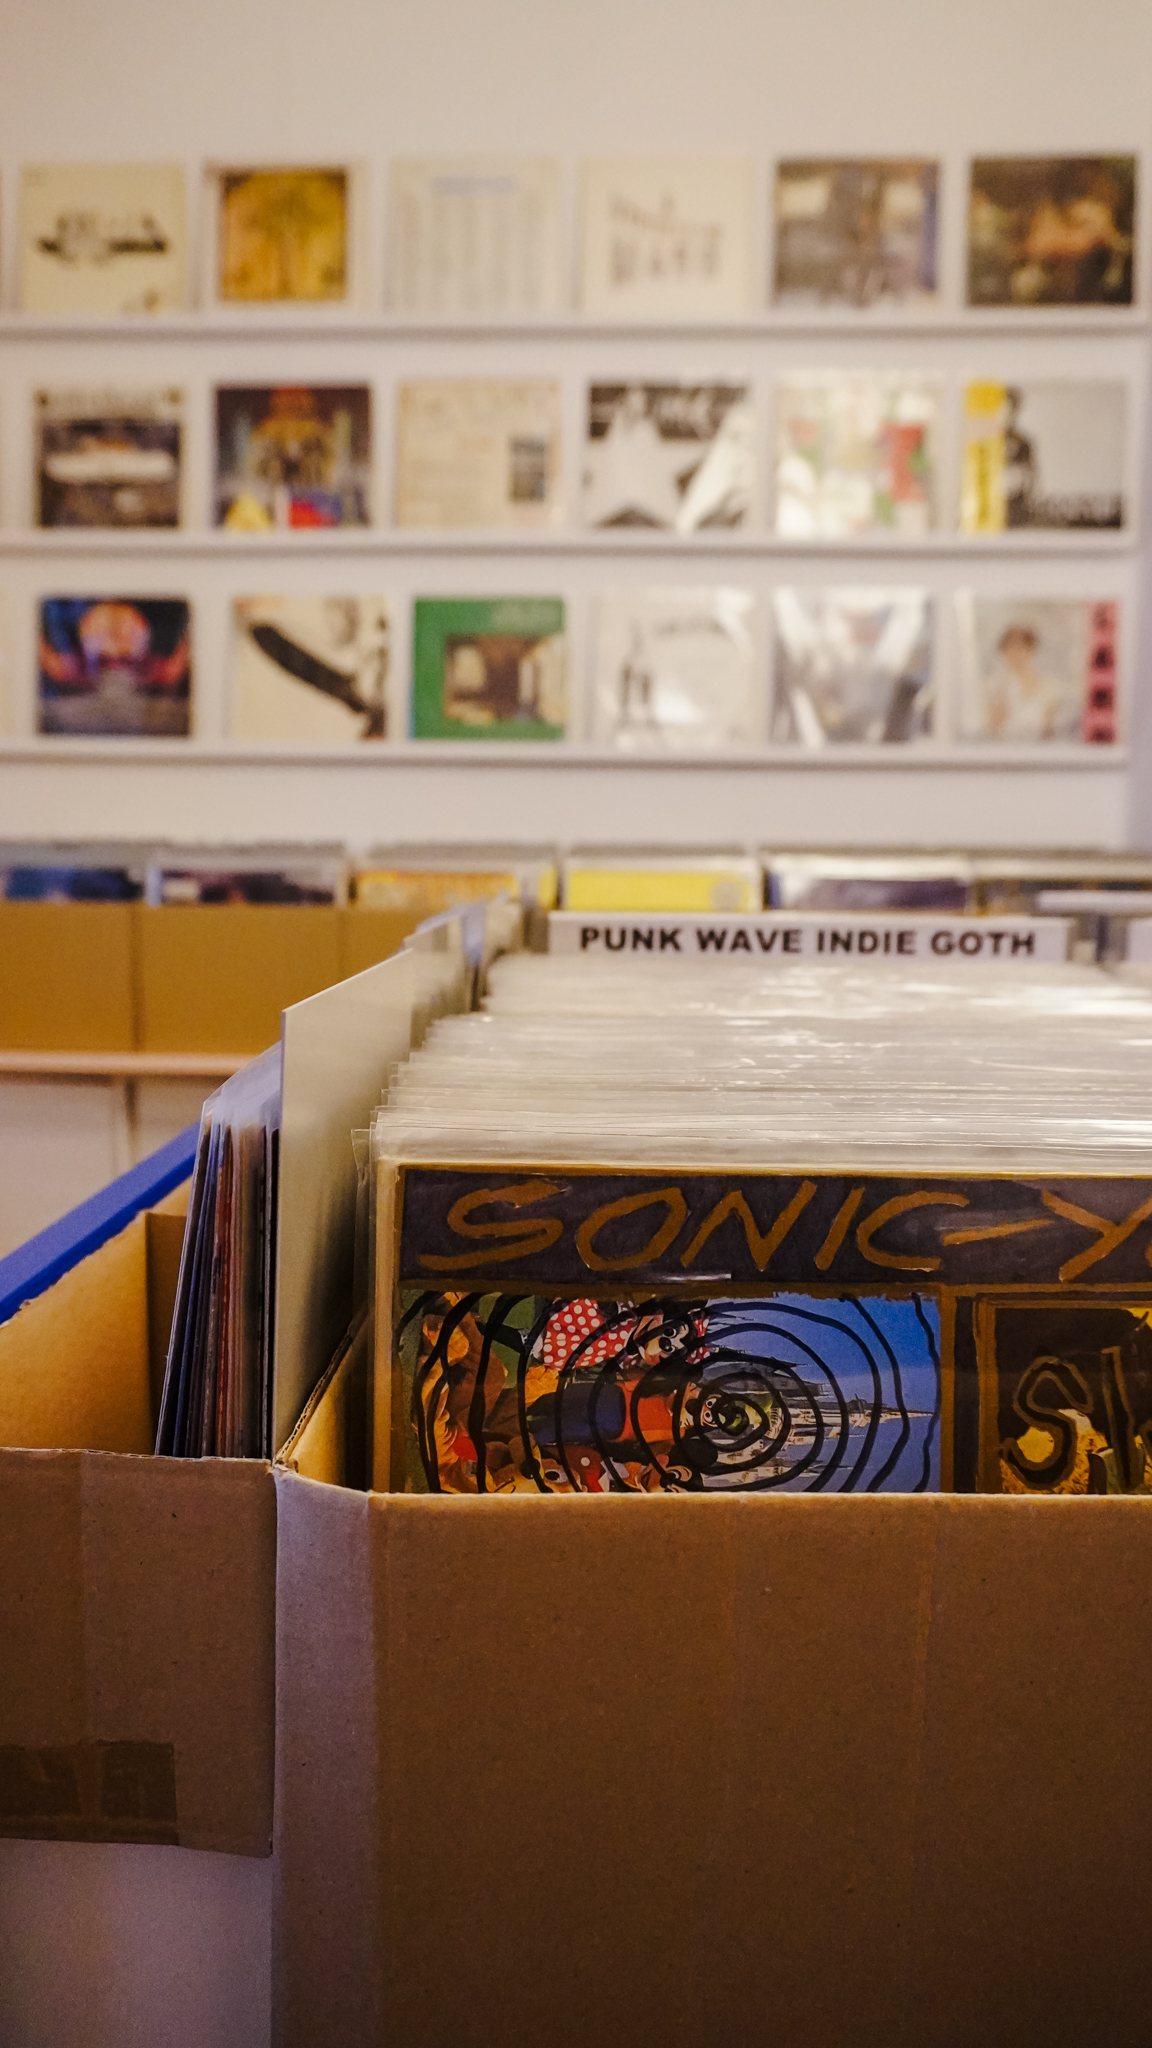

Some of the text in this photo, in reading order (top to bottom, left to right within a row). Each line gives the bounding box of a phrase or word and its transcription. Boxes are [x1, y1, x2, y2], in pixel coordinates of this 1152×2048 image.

[580, 926, 1035, 956] PUNK WAVE INDIE GOTH
[999, 1346, 1152, 1494] SI
